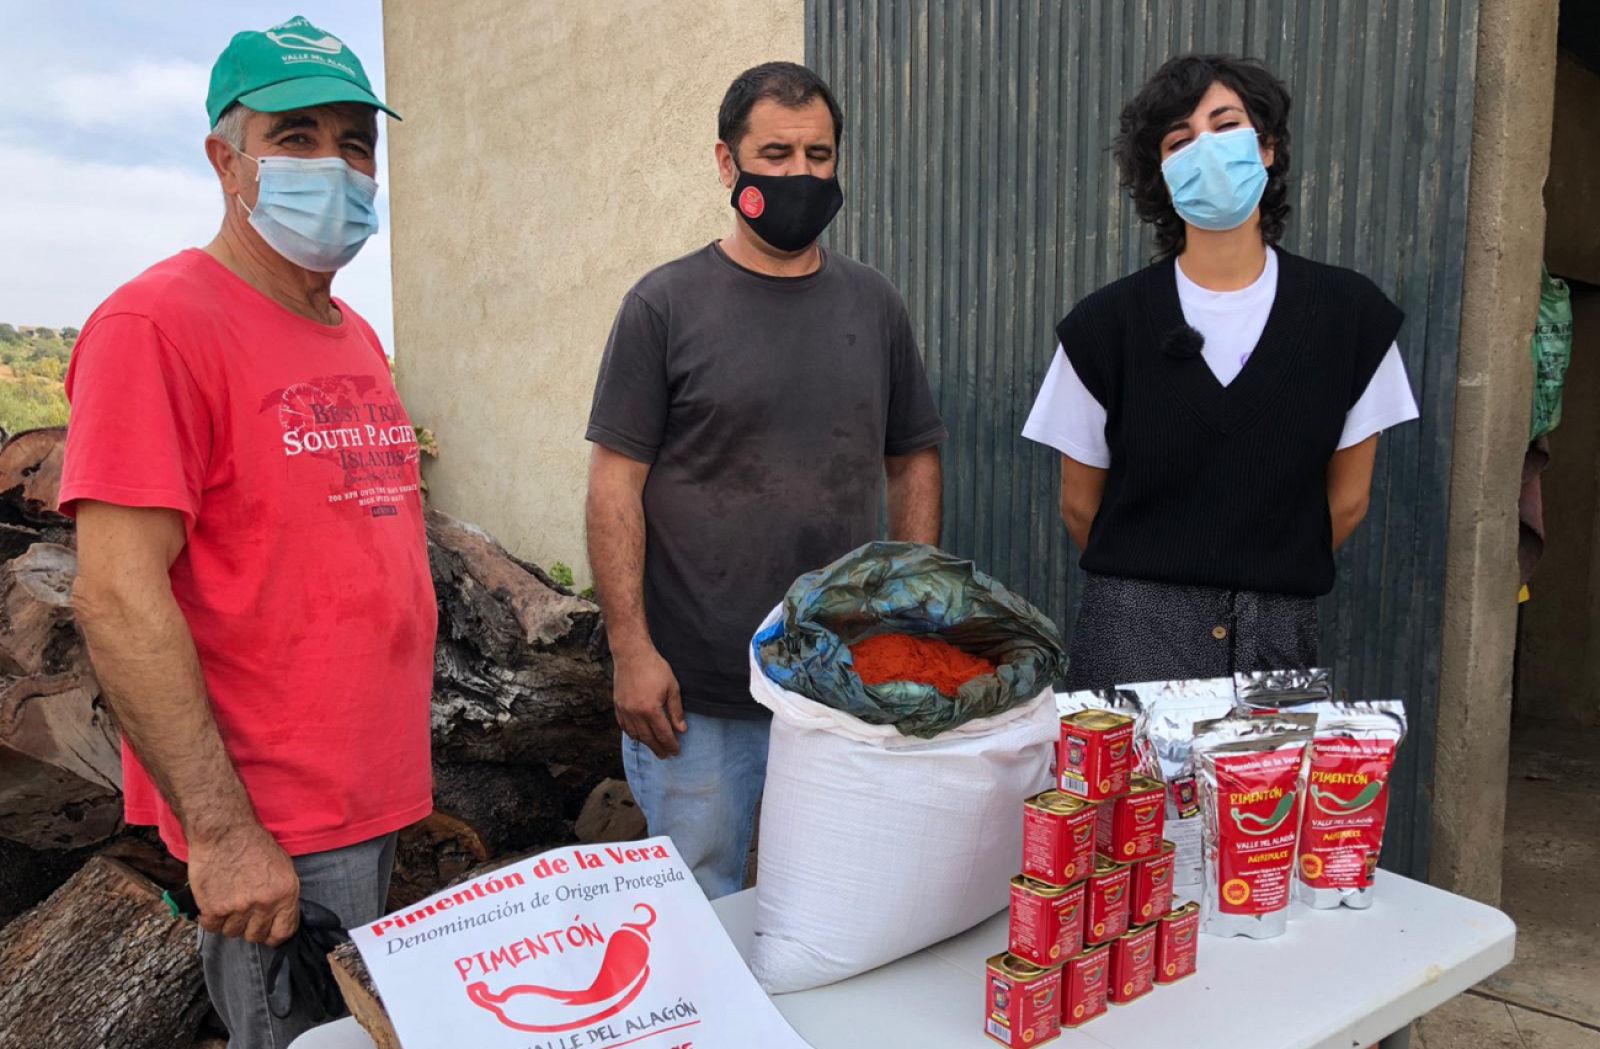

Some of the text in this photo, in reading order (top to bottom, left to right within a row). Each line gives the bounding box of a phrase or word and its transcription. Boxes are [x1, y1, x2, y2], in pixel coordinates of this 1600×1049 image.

[311, 403, 360, 424] BEST
[283, 427, 363, 456] SOUTH
[338, 449, 405, 470] ISLANDS
[1311, 770, 1368, 784] PIMENTÓN
[1230, 785, 1282, 805] PIMENTÓN
[1236, 840, 1258, 849] VALLE
[371, 844, 670, 937] Pimentón de la Vera
[386, 867, 684, 956] Denominación de Origen Protegida
[454, 914, 605, 982] PIMENTÓN
[527, 997, 698, 1049] LLE DEL ALAGÓN
